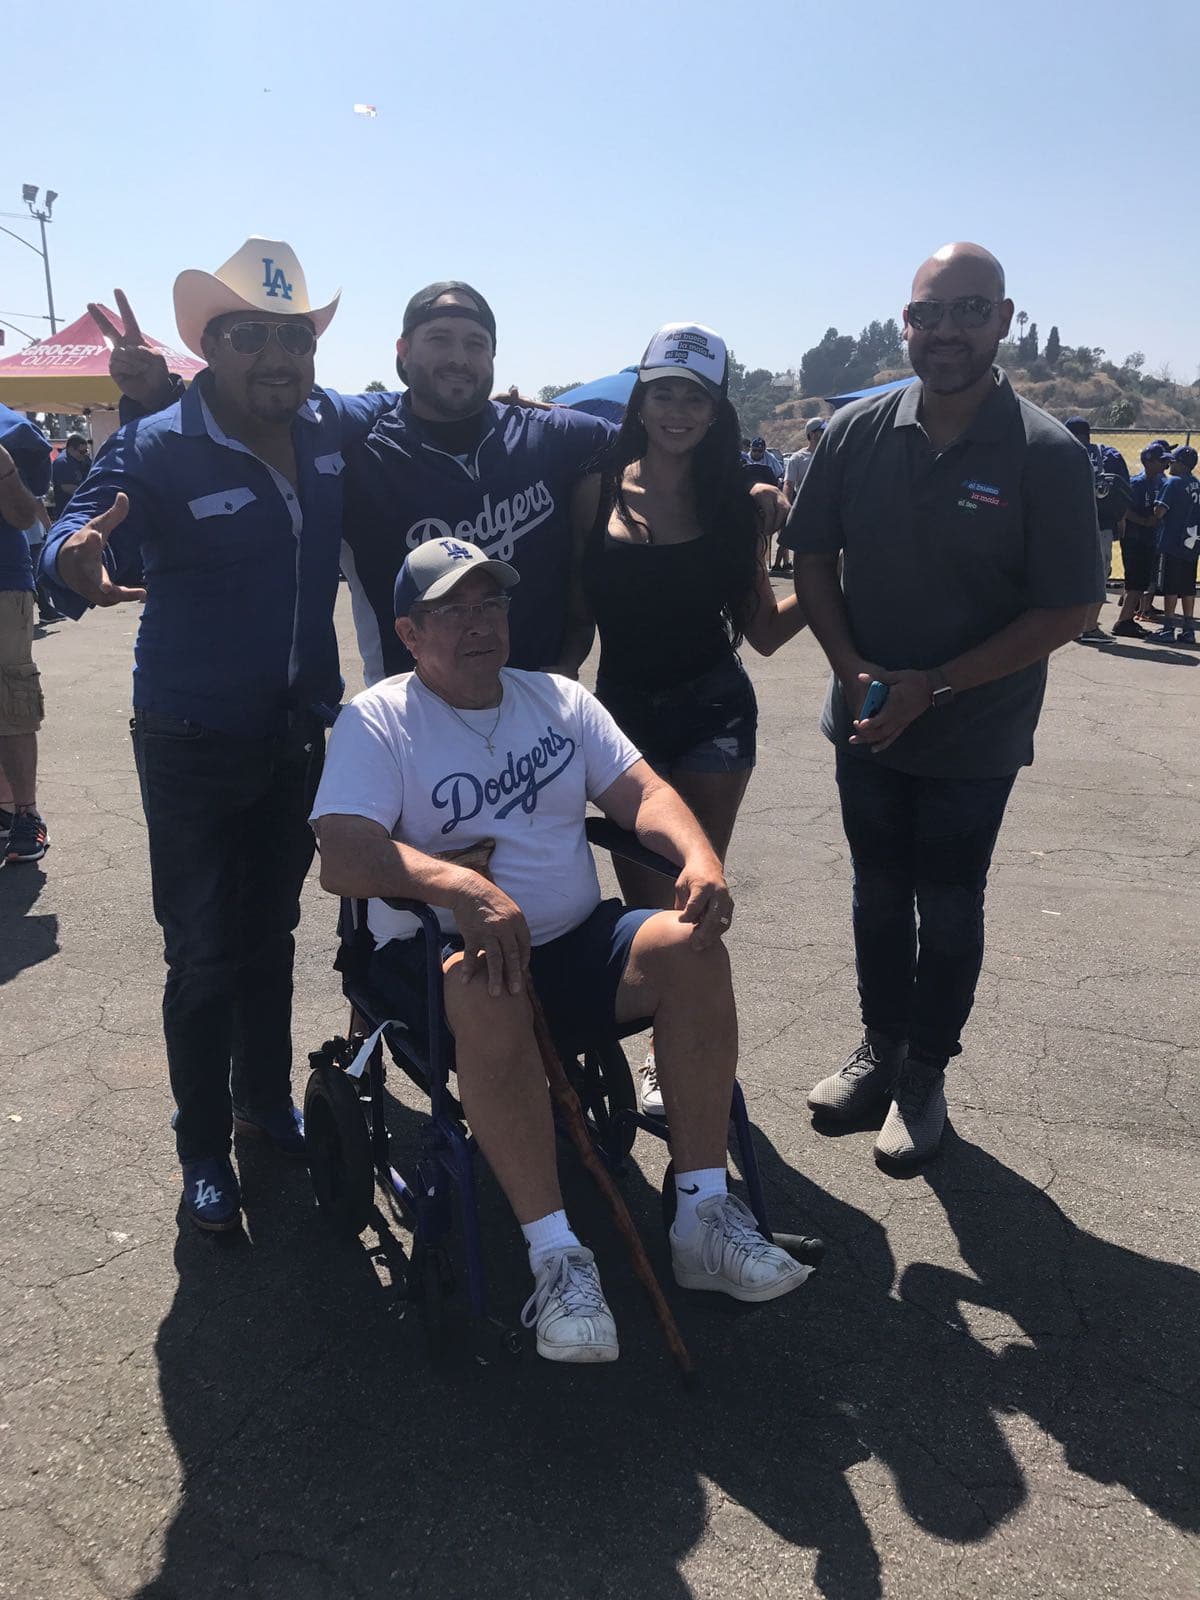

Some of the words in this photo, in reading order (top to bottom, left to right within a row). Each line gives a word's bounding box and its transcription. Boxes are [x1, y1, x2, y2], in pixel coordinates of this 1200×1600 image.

[262, 258, 293, 300] LA
[21, 344, 108, 356] GROCERY
[21, 355, 88, 366] OUTLET
[406, 480, 555, 561] Dodgers
[440, 541, 473, 560] LA
[431, 726, 576, 835] Dodgers
[194, 1179, 222, 1210] LA
